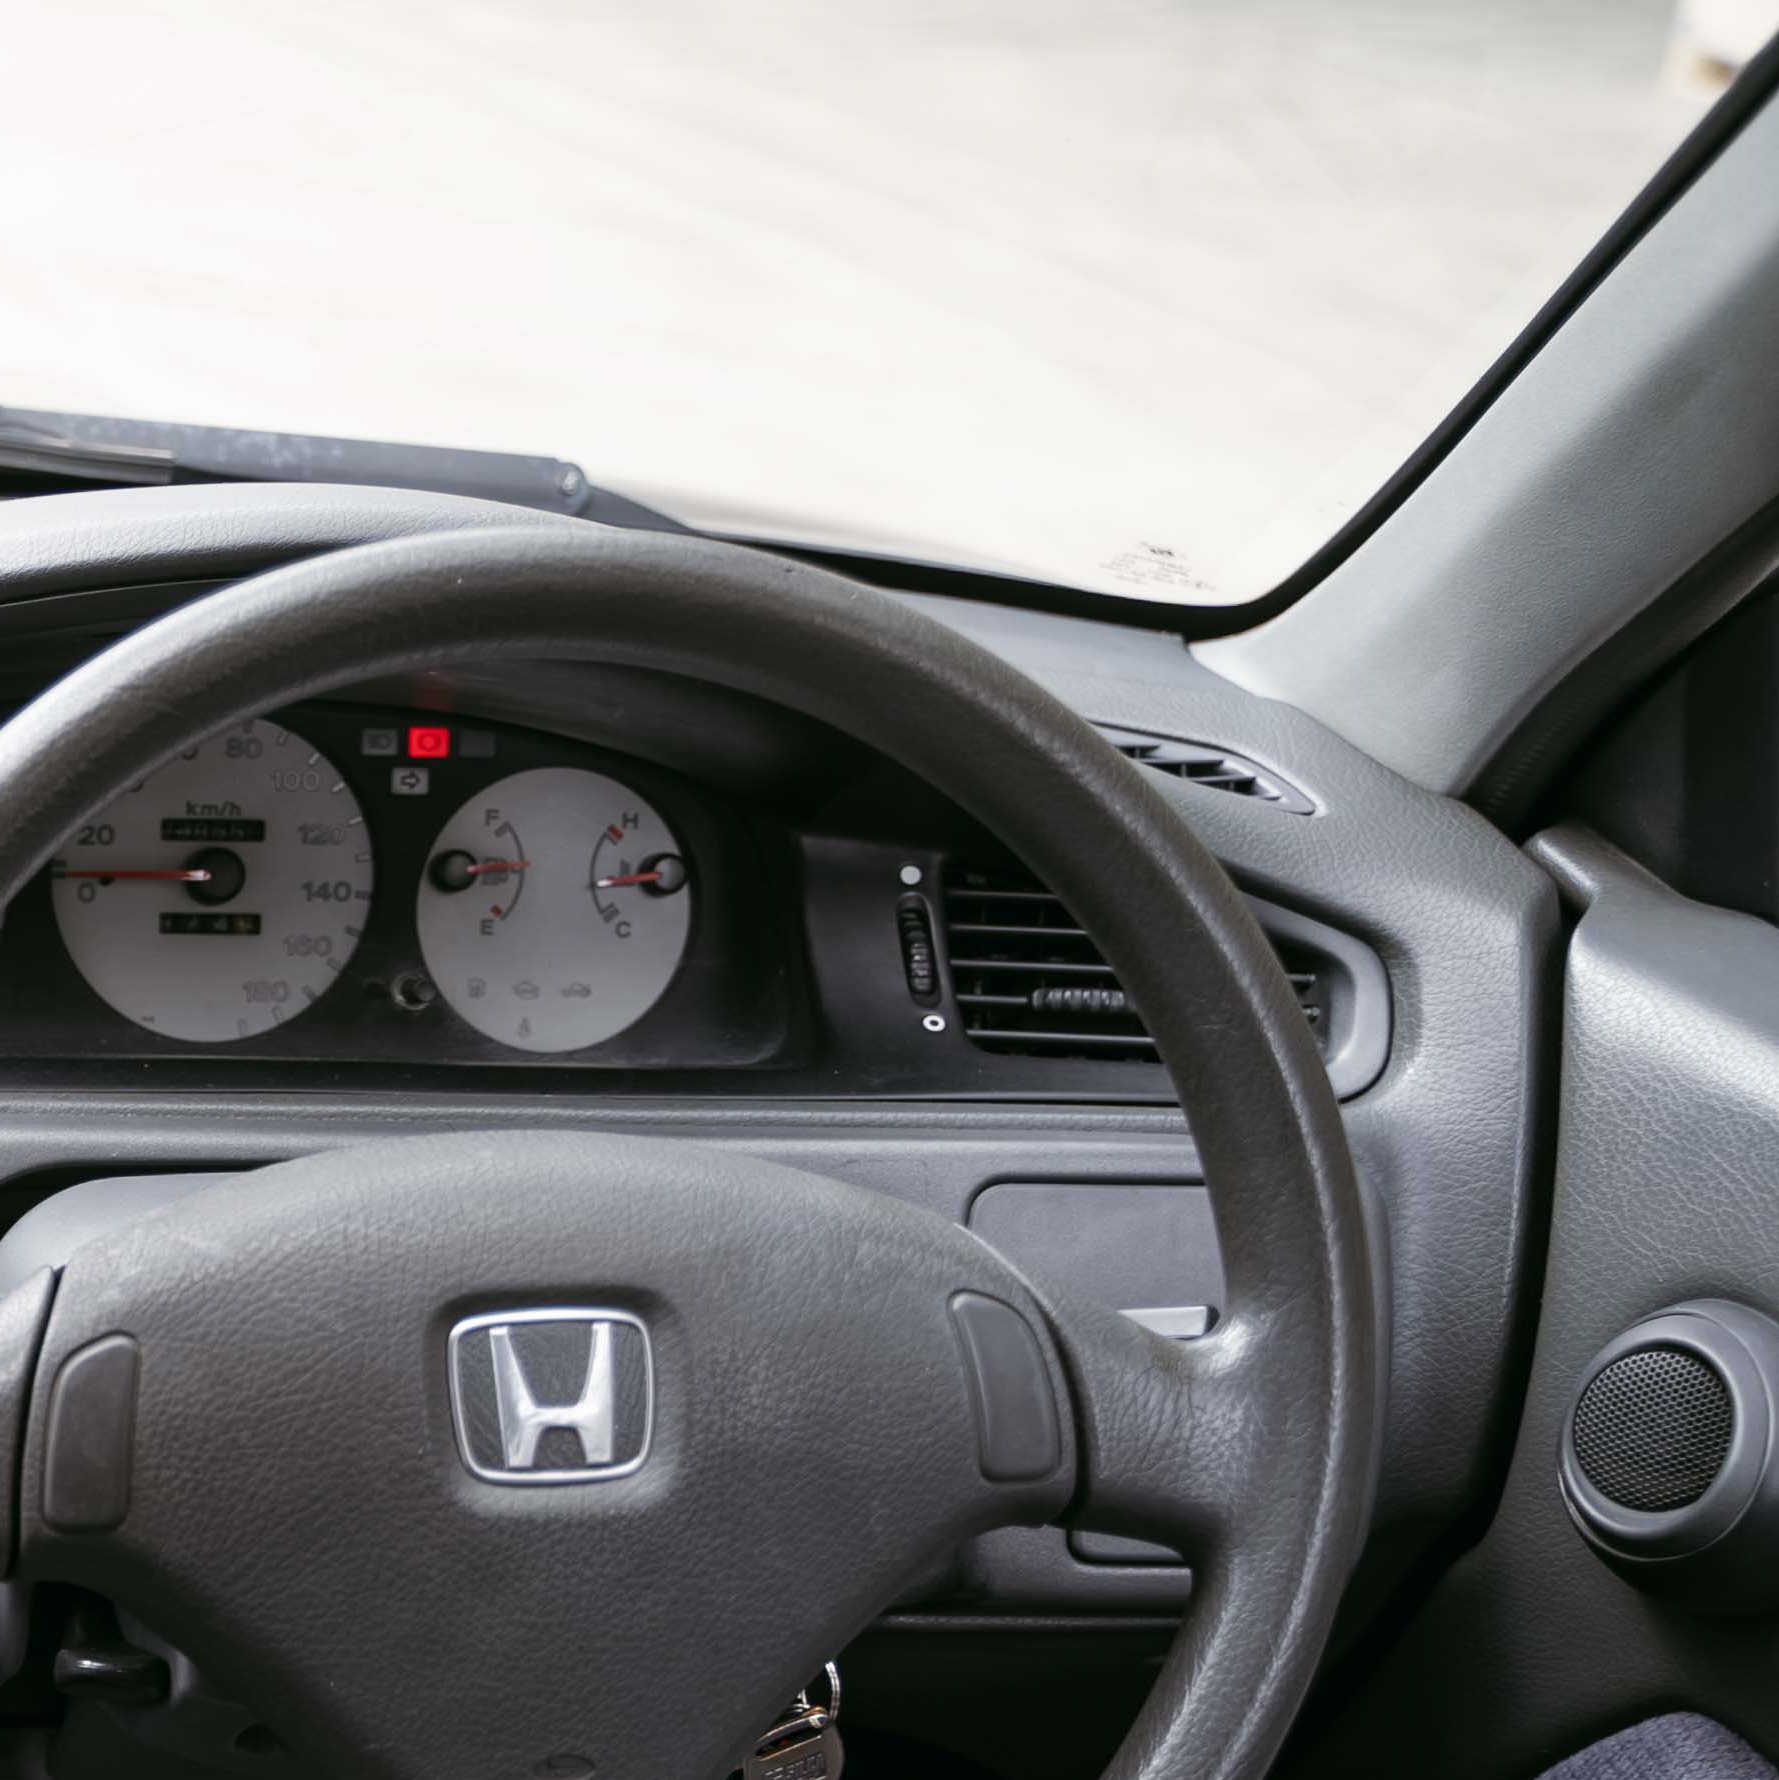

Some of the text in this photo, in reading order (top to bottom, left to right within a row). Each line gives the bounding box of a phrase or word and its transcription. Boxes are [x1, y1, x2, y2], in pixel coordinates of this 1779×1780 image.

[225, 736, 263, 760] 80
[271, 768, 323, 792] 100
[185, 801, 242, 818] km/h
[485, 808, 500, 827] F
[622, 811, 639, 831] H
[79, 825, 114, 846] 20
[297, 824, 347, 847] 120
[79, 883, 96, 902] 0
[300, 880, 353, 903] 140
[480, 918, 495, 937] E
[615, 921, 631, 938] C
